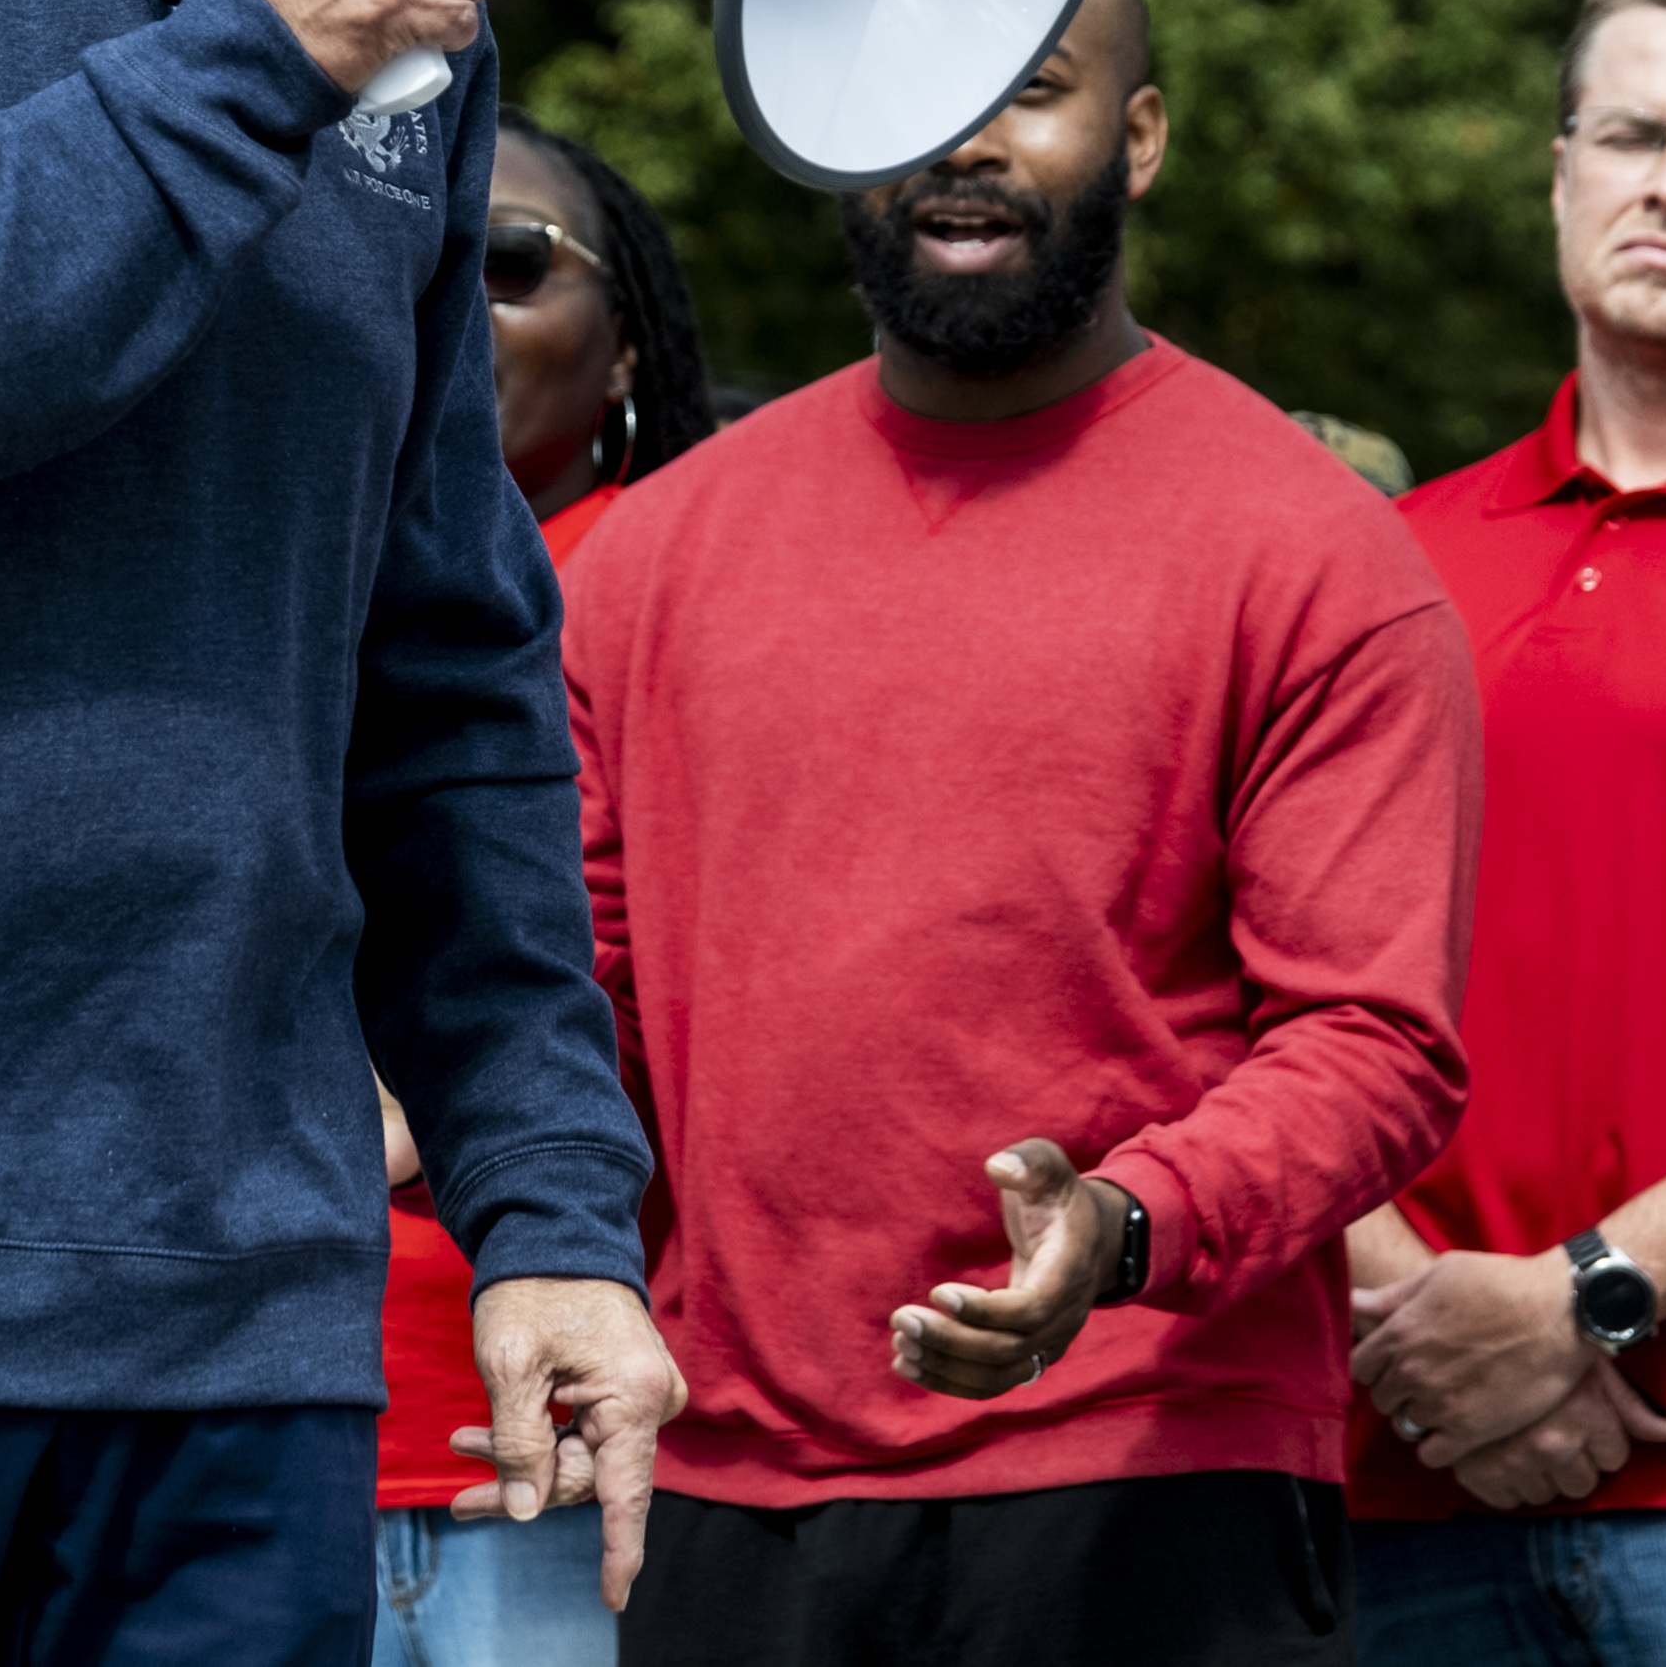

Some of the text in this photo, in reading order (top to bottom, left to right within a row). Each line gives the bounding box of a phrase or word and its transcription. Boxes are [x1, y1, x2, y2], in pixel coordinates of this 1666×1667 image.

[408, 110, 428, 155] ATES
[363, 174, 402, 201] FORCE
[402, 189, 431, 211] ONE
